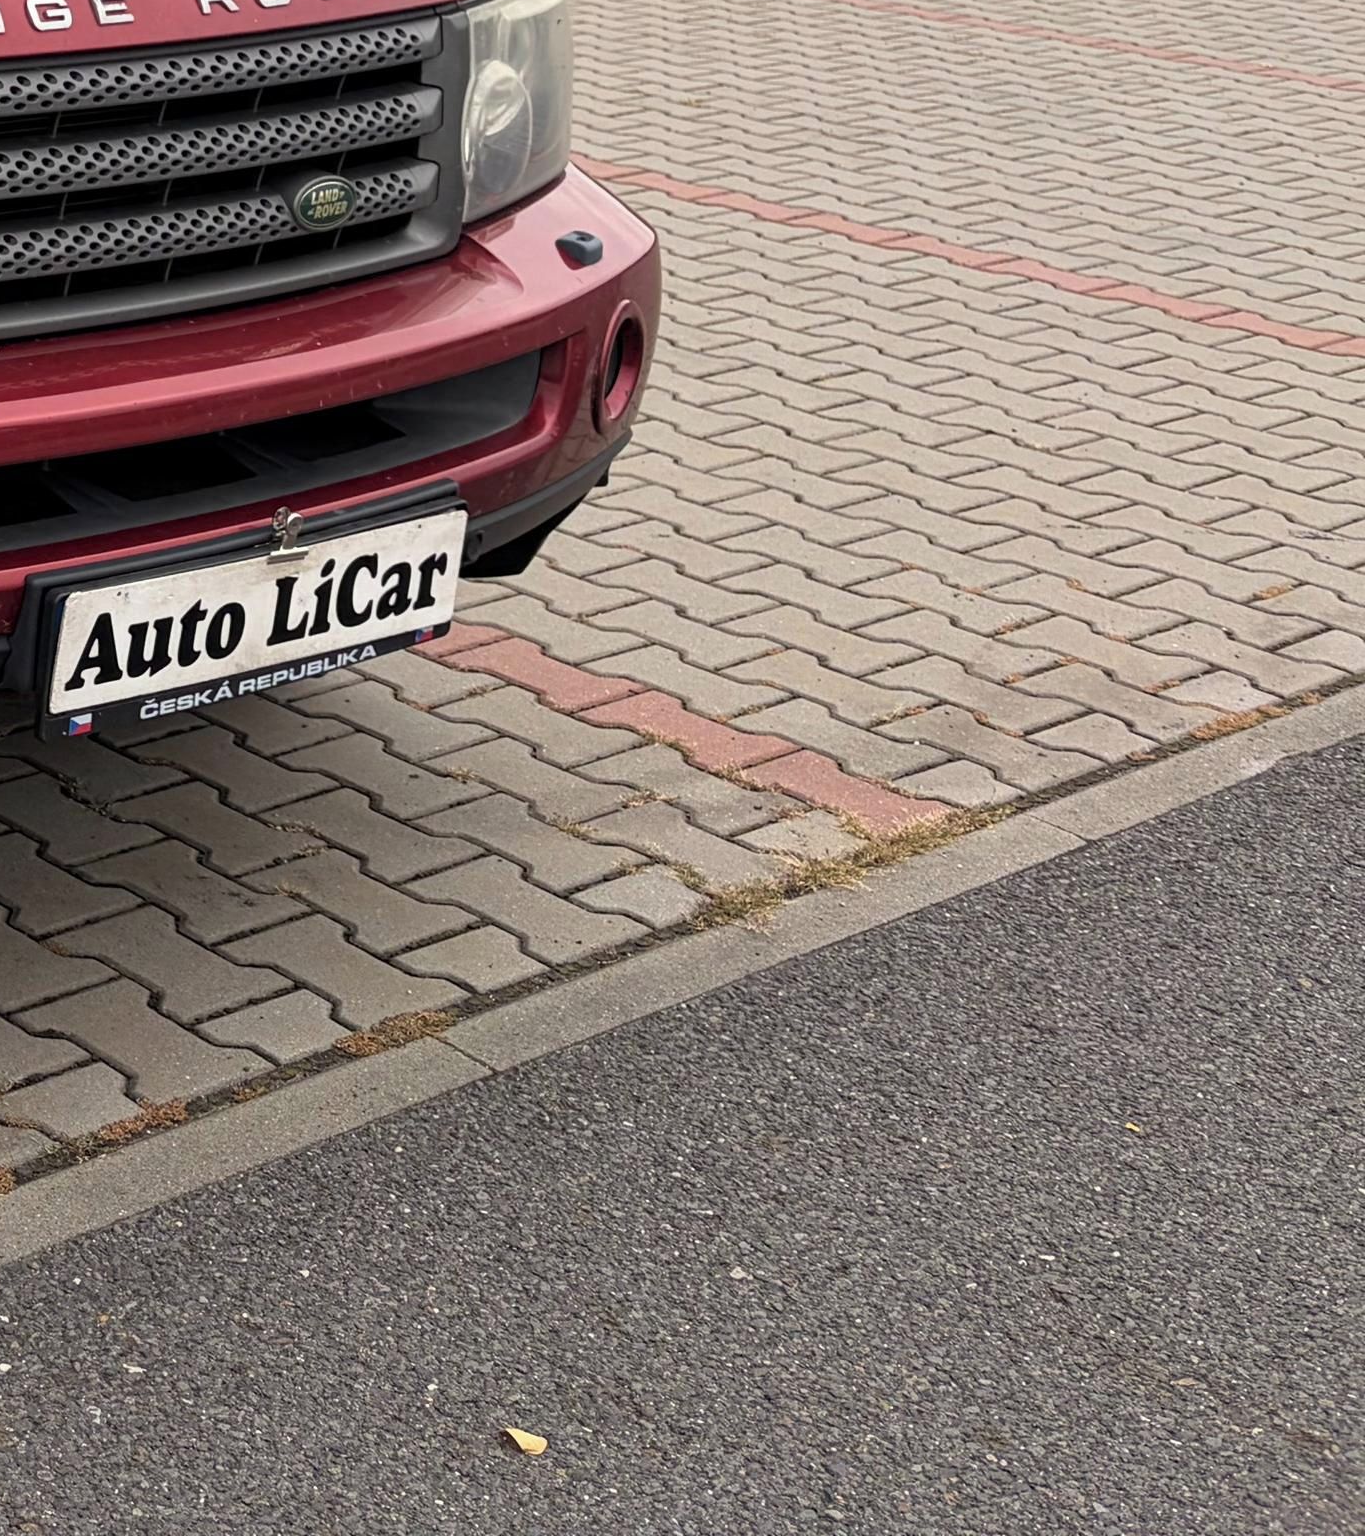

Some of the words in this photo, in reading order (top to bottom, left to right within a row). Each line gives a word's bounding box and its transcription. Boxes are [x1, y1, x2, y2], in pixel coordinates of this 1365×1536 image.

[312, 189, 339, 205] LAND
[315, 201, 348, 218] ROVER
[64, 599, 247, 692] Auto
[266, 552, 449, 647] LiCar
[139, 682, 235, 721] ČESKÁ
[238, 644, 378, 696] REPUBLIKA
